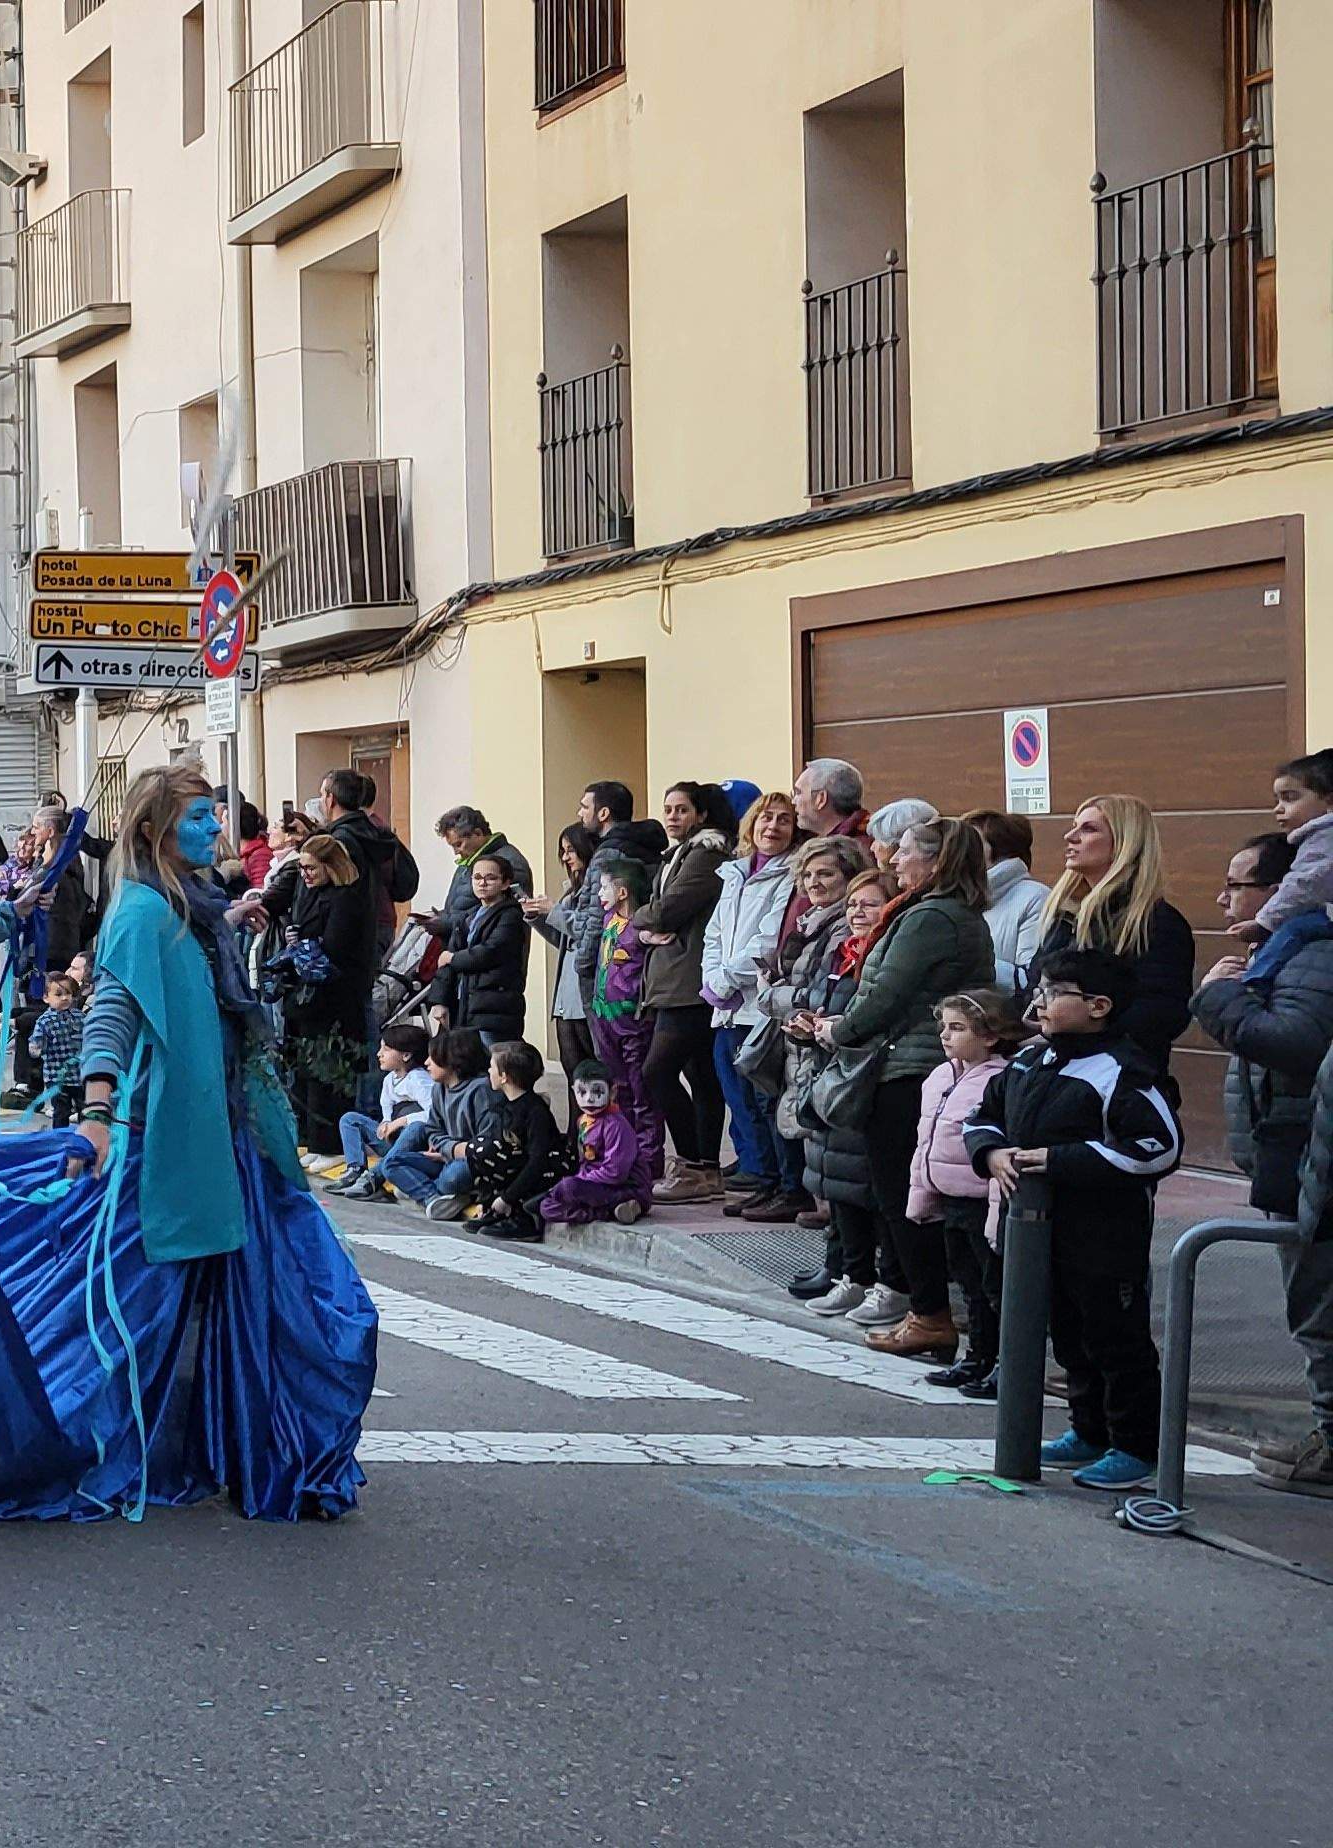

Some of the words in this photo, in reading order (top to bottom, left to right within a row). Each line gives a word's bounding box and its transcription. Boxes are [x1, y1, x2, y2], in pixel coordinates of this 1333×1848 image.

[41, 555, 78, 571] hotel
[41, 574, 93, 587] Posada
[97, 574, 115, 587] de
[119, 575, 132, 587] la
[137, 575, 172, 587] Luna
[37, 604, 84, 617] hostal
[37, 618, 65, 635] Un
[71, 619, 132, 637] Puto
[137, 619, 182, 637] Chic
[81, 658, 133, 676] otras
[138, 658, 252, 680] direccios
